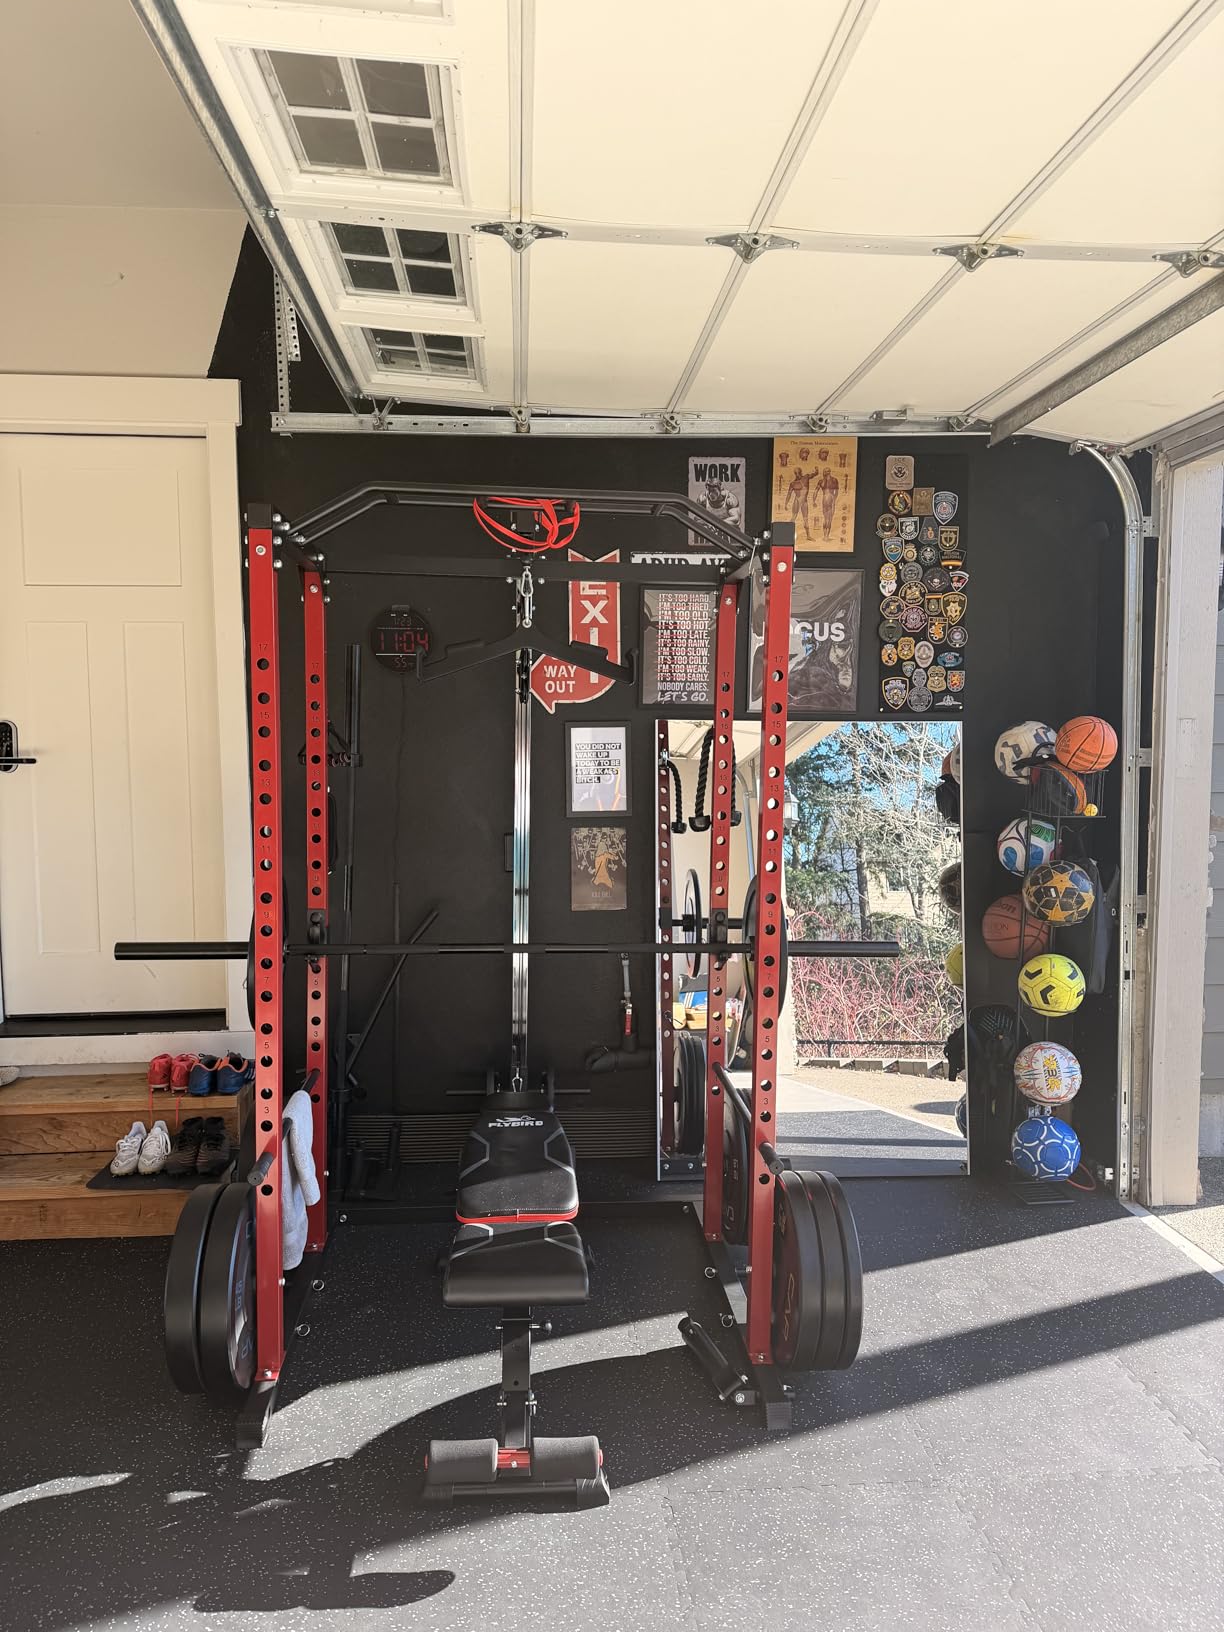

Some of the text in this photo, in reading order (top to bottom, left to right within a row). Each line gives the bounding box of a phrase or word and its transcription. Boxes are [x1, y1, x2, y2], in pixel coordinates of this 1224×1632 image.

[694, 464, 741, 482] WORK
[659, 594, 711, 602] IT'S TOO HARD.
[658, 603, 710, 611] I'M TOO TIRED.
[658, 611, 710, 620] I'M TOO OLD.
[658, 621, 711, 630] IT'S TOO HOT.
[658, 630, 710, 639] I'M TOO LATE.
[380, 631, 429, 653] 11:04
[658, 639, 710, 647] IT'S TOO RAINY.
[258, 643, 268, 651] 17
[658, 648, 710, 656] I'M TOO SLOW.
[658, 656, 710, 664] IT'S TOO COLD.
[543, 665, 577, 678] WAY
[658, 665, 710, 673] I'M TOO WEAK.
[658, 673, 709, 681] IT'S TOO EARLY.
[545, 680, 576, 694] OUT
[657, 682, 709, 691] NOBODY CARES.
[657, 691, 709, 703] LET'S GO.
[259, 712, 270, 720] 15
[771, 720, 782, 728] 15
[770, 784, 780, 792] 13
[264, 911, 270, 919] 9
[768, 910, 774, 918] 9
[264, 976, 270, 984] 7
[313, 978, 319, 986] 5
[313, 1030, 319, 1038] 3
[765, 1035, 770, 1043] 5
[264, 1041, 270, 1050] 5
[763, 1097, 769, 1105] 3
[264, 1106, 270, 1114] 3
[488, 1120, 544, 1128] FLYBIRD
